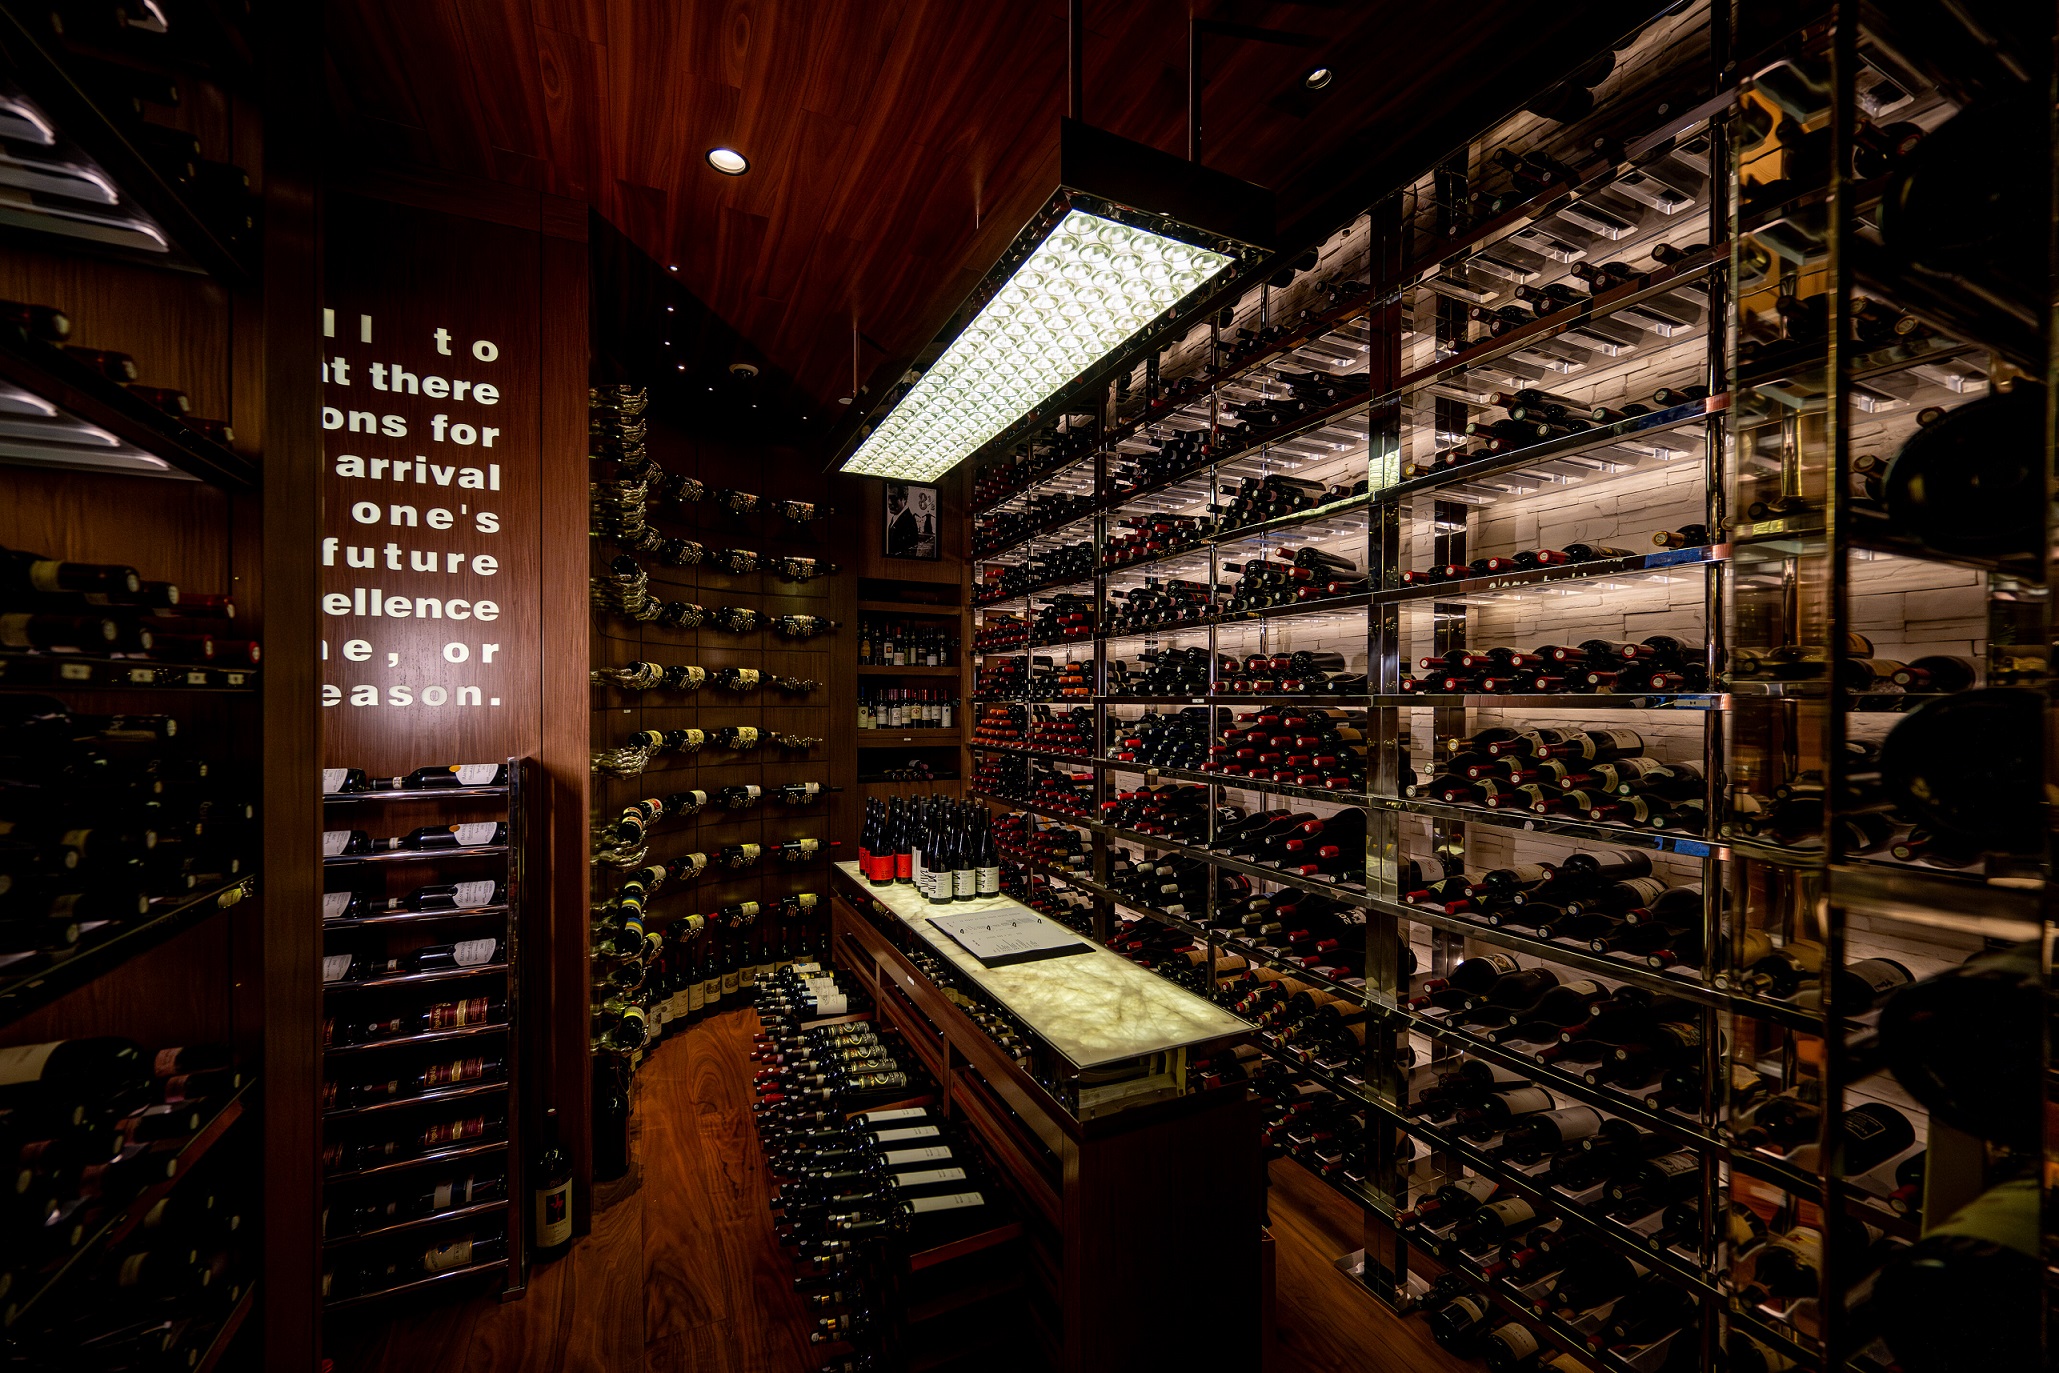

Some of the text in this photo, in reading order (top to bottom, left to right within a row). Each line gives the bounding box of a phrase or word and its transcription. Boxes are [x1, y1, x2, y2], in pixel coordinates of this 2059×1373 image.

[433, 327, 499, 363] to
[368, 362, 500, 406] there
[322, 406, 500, 448] ons for
[335, 454, 500, 492] arrival
[351, 501, 500, 534] one's
[322, 537, 499, 576] future
[322, 587, 500, 622] ellence
[442, 641, 500, 664] or
[322, 684, 501, 707] eason.
